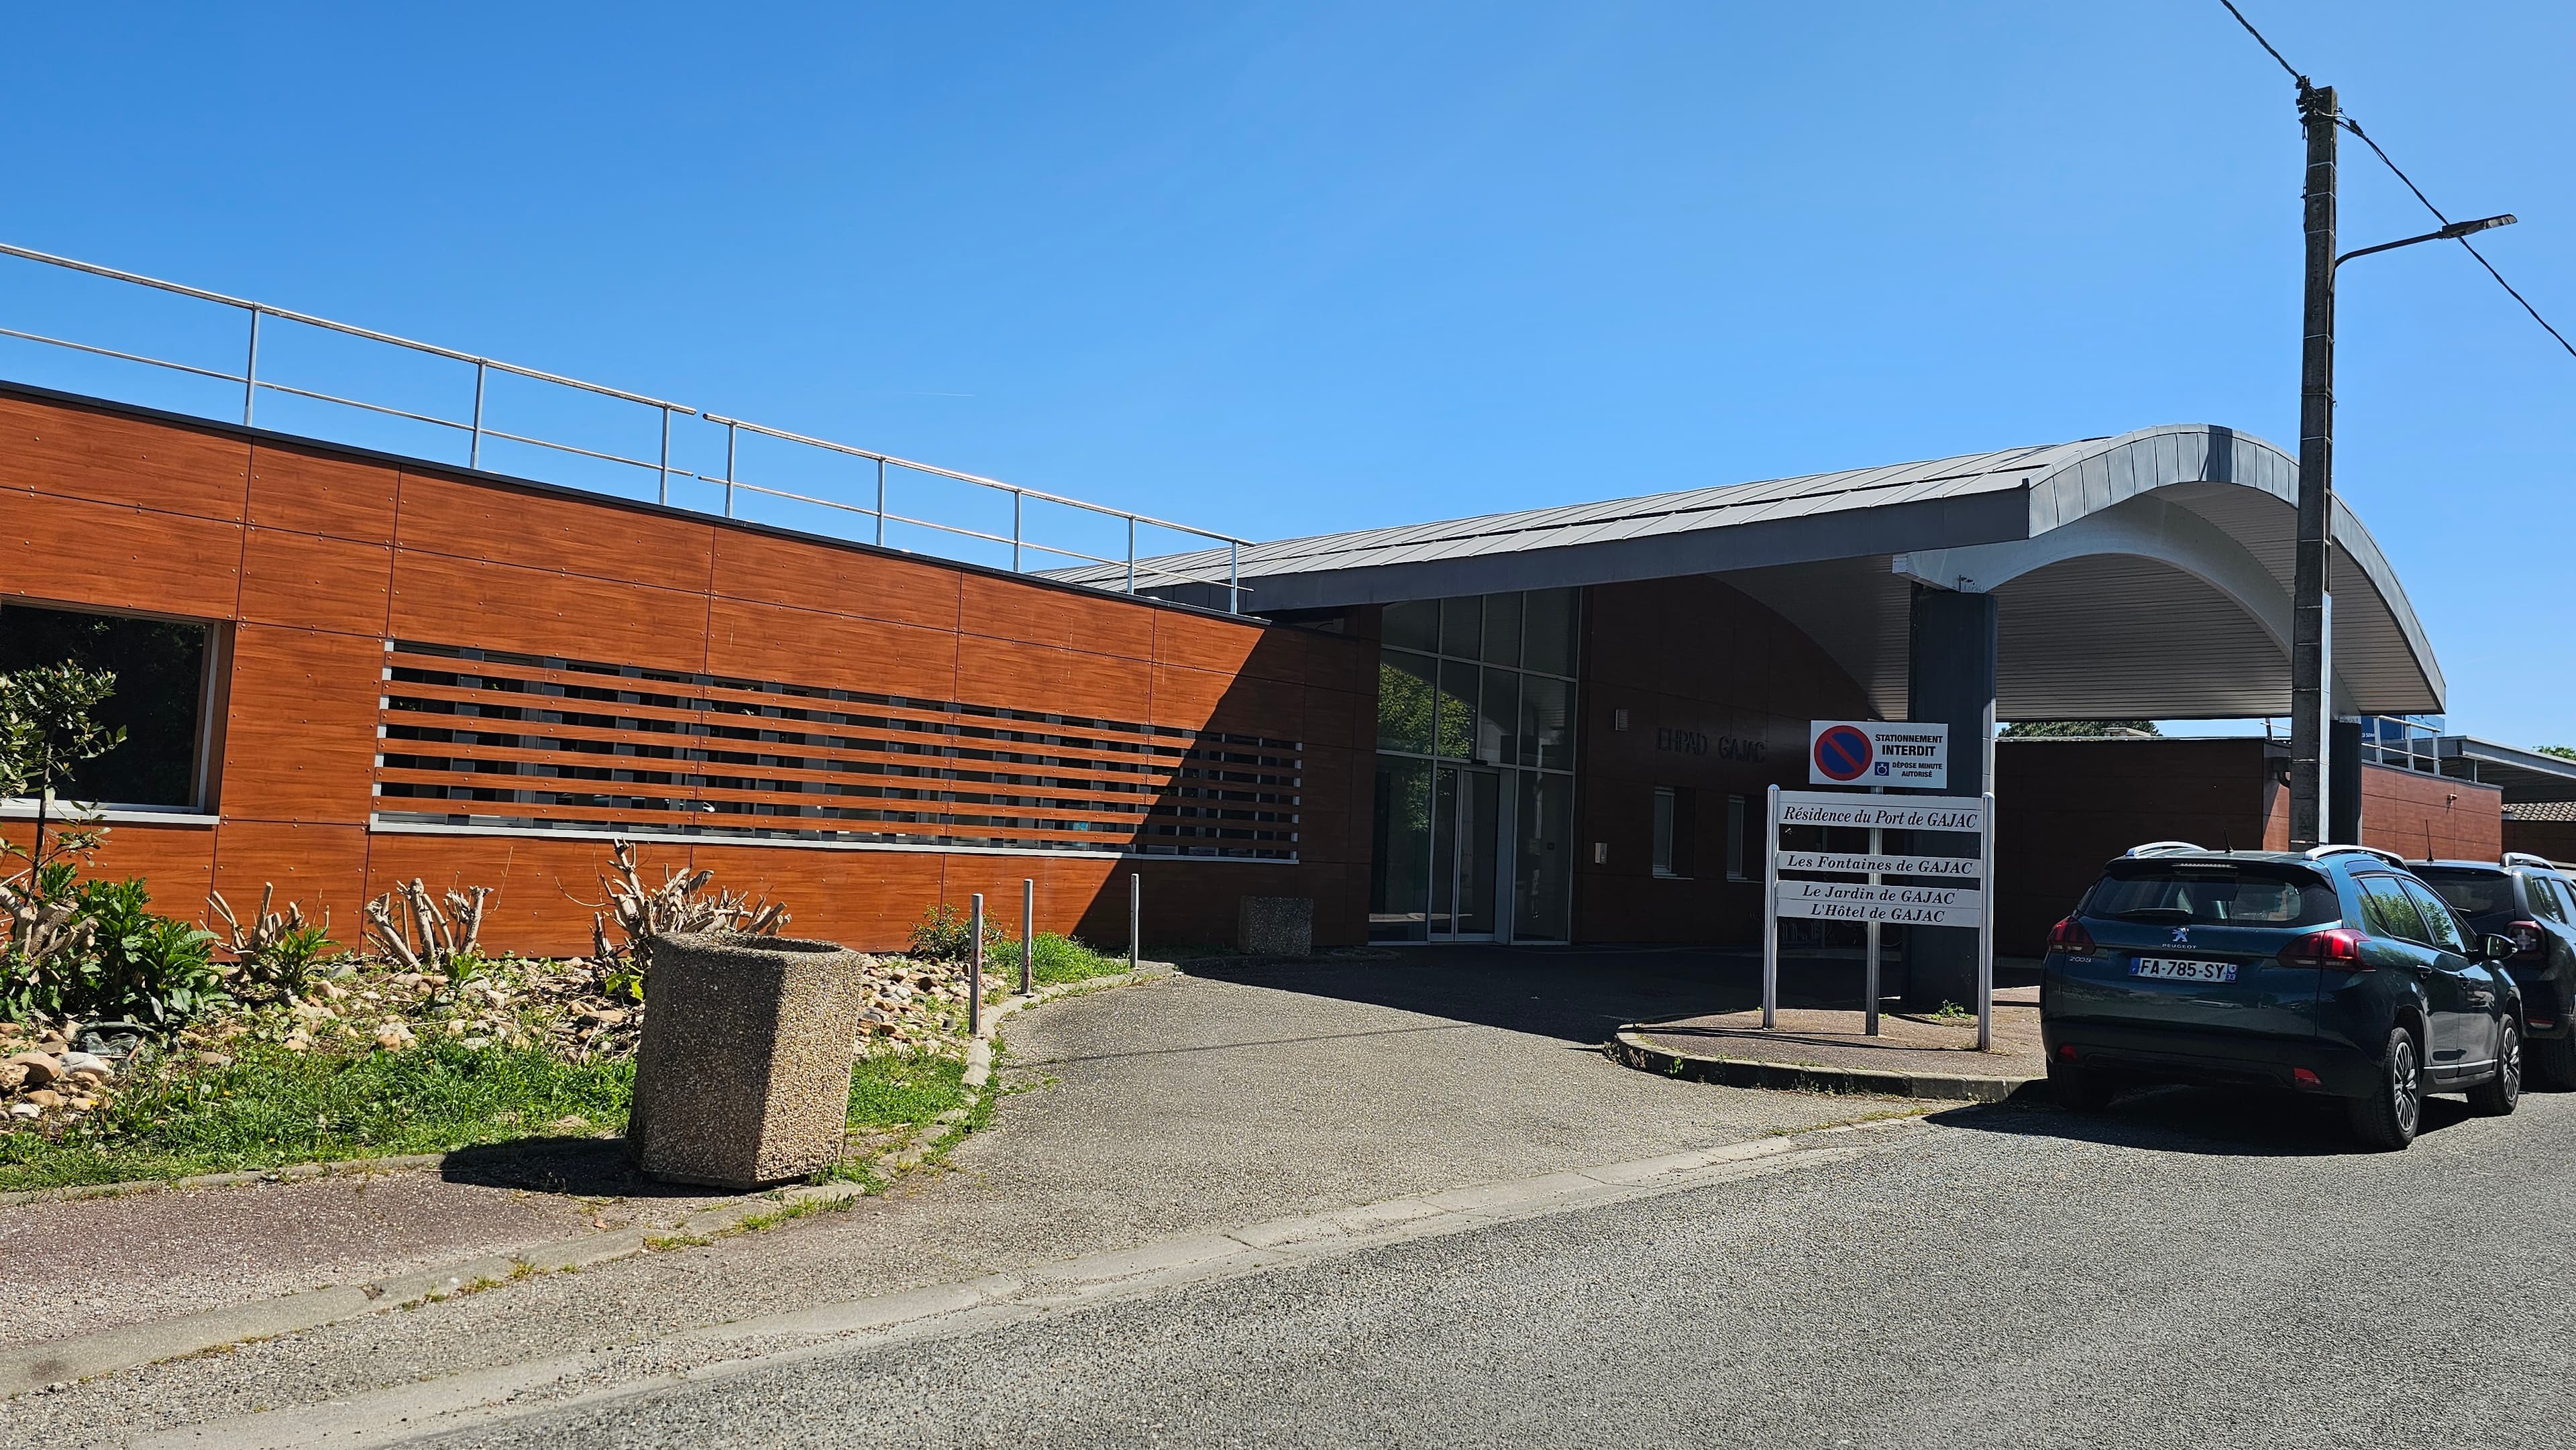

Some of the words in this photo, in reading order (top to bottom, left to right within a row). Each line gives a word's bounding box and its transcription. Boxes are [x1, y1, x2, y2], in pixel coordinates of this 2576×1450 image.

[1658, 727, 1708, 757] EHPAD
[1718, 735, 1766, 763] GAJAC
[1875, 734, 1943, 743] STATIONNEMENT
[1882, 744, 1936, 757] INTERDIT
[1892, 761, 1917, 769] DÉPOSE
[1783, 806, 1851, 822] Résidence
[1854, 810, 1871, 823] du
[1874, 810, 1905, 825] Port
[1908, 812, 1924, 826] de
[1927, 812, 1978, 828] GAJAC
[1787, 854, 1813, 867] Les
[1817, 856, 1892, 871] Fontaines
[1896, 860, 1913, 872] de
[1919, 860, 1974, 875] GAJAC
[1803, 885, 1821, 897] Le
[1825, 886, 1874, 901] Jardin
[1879, 889, 1896, 901] de
[1901, 890, 1955, 905] GAJAC
[1811, 903, 1865, 918] L'Hôtel
[1869, 907, 1886, 919] de
[1891, 908, 1946, 923] GAJAC
[2140, 960, 2226, 979] FA-785-SY
